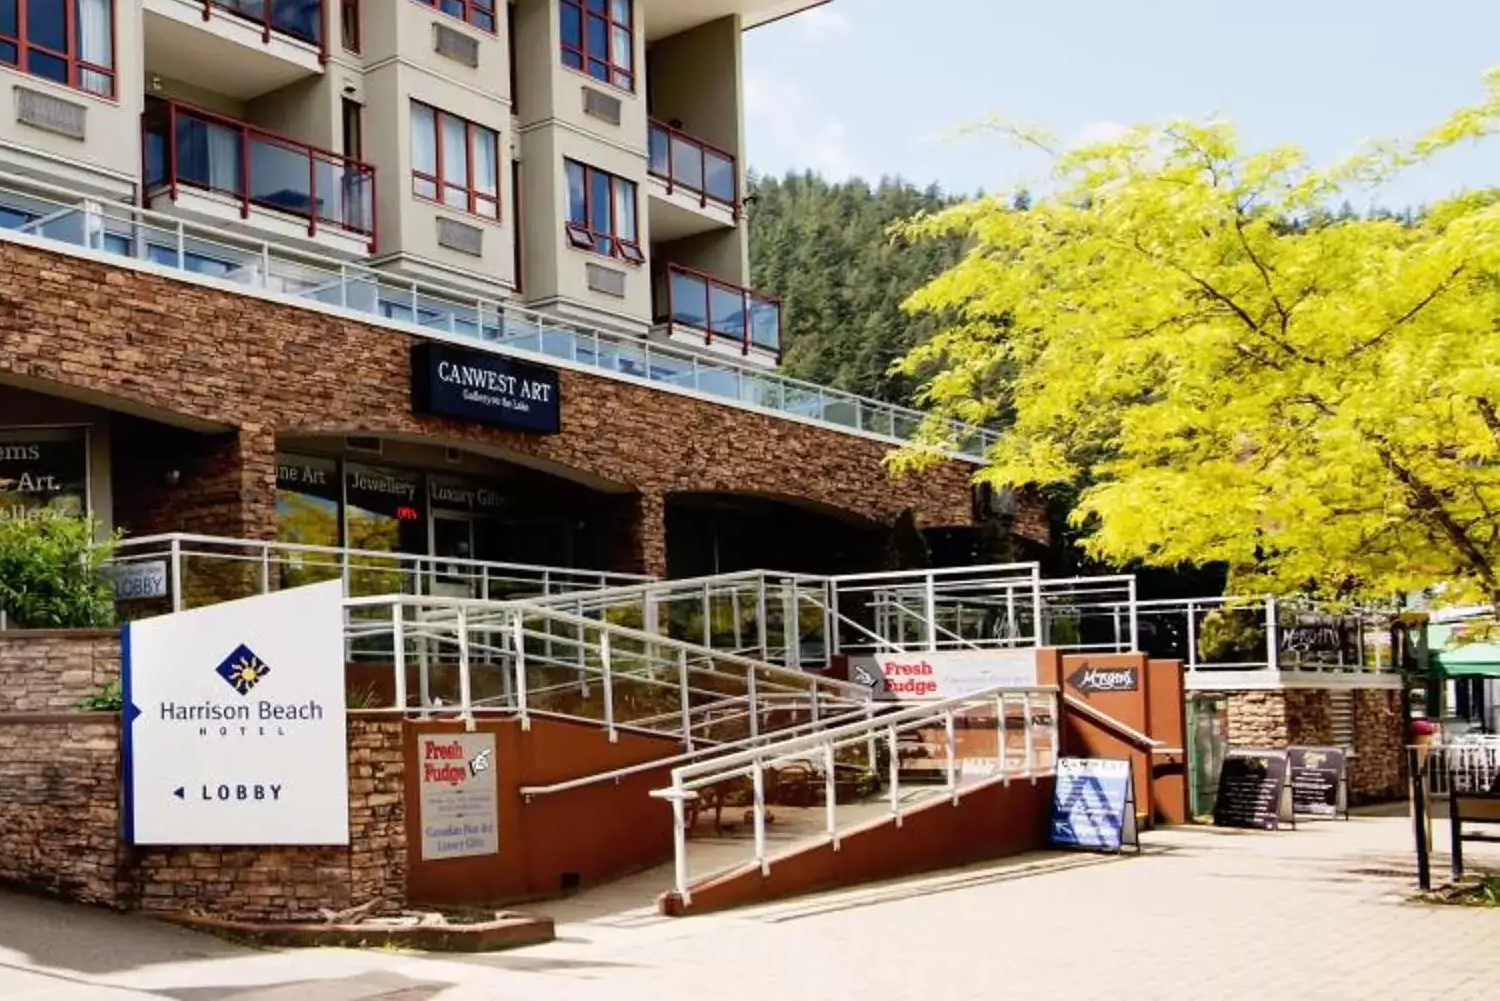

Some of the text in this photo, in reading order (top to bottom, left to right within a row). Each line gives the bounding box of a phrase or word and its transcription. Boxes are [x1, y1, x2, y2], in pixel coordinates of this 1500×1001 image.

[438, 361, 551, 402] CANWEST ART
[302, 465, 326, 485] Art
[352, 471, 417, 502] Jewellery
[116, 576, 163, 598] LOBBY
[884, 660, 933, 676] Fresh
[883, 678, 937, 696] Fudge
[160, 700, 323, 721] Harrison Beach
[199, 726, 284, 736] HOTEL
[424, 740, 464, 760] Fresh
[424, 762, 467, 786] Fudge
[201, 784, 282, 801] LOBBY
